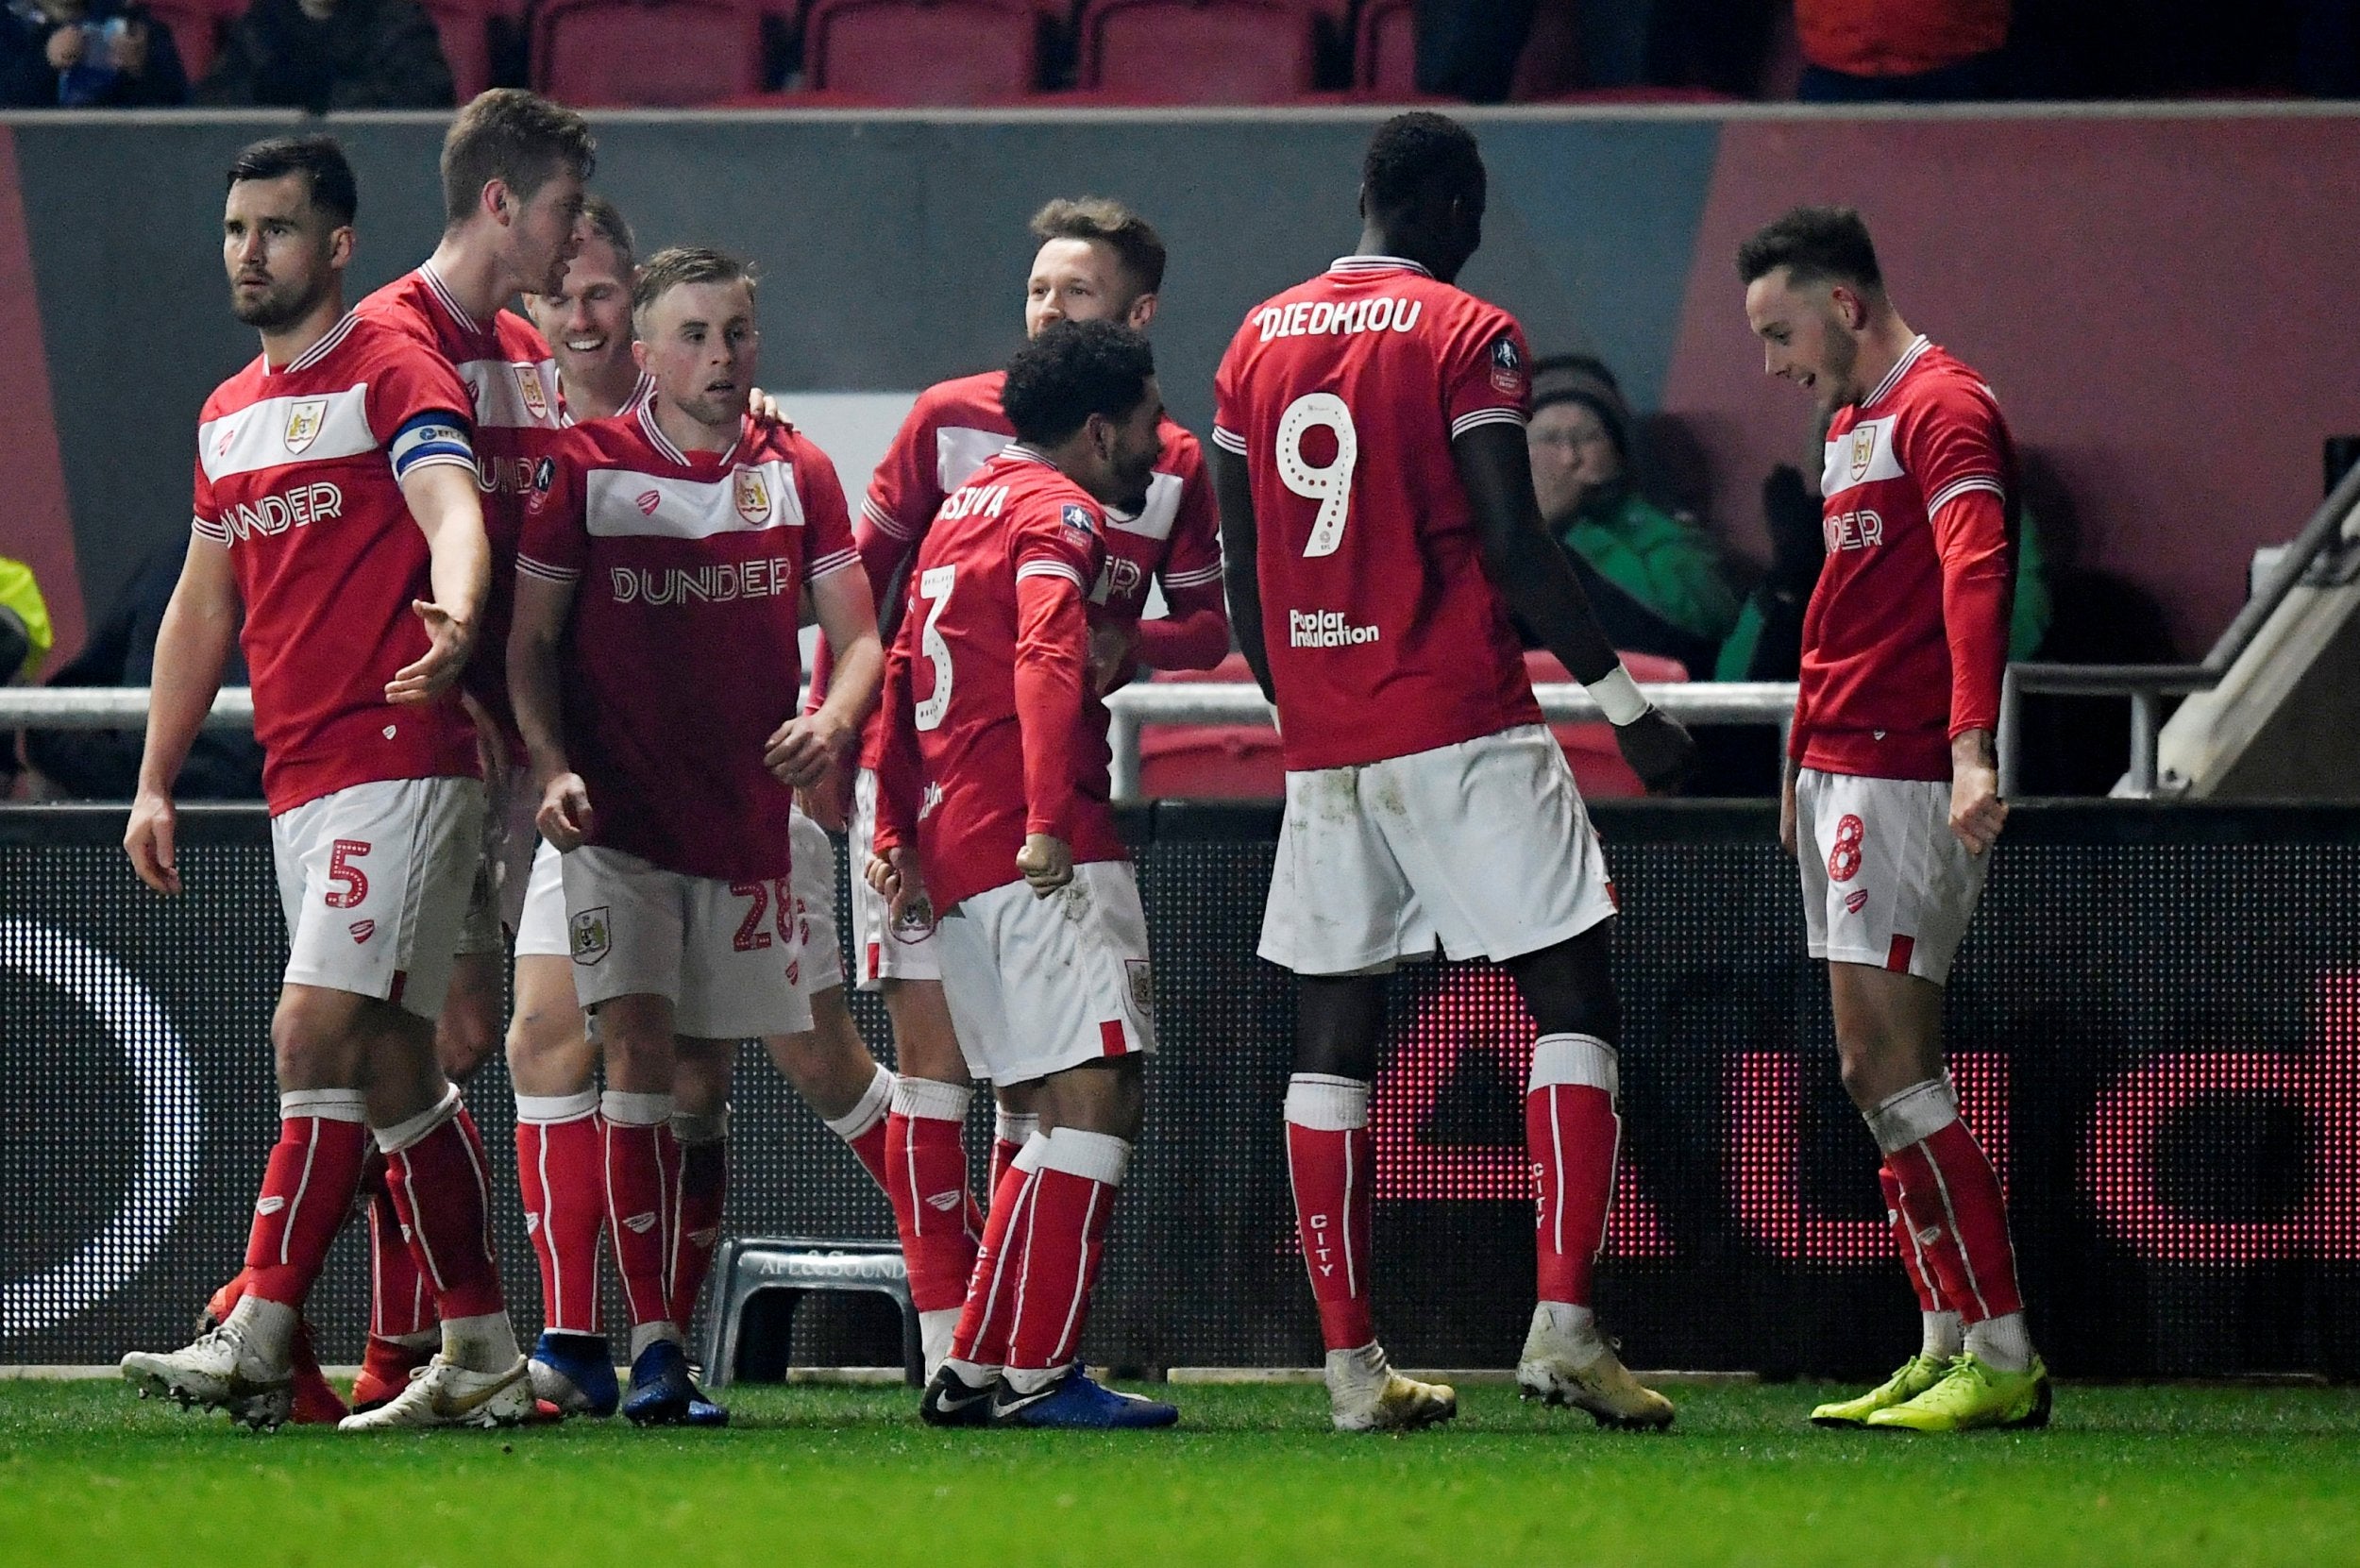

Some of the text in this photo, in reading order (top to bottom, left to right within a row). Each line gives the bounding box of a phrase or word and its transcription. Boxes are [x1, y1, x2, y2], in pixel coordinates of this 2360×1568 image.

[1252, 297, 1423, 343] DIEDHIOU
[1275, 392, 1357, 558] 9
[610, 557, 791, 605] DUNDER
[915, 564, 956, 733] 3
[1290, 625, 1380, 649] Inulation
[325, 838, 372, 909] 5
[1829, 814, 1864, 883] 8
[729, 879, 793, 953] 28
[966, 1246, 988, 1303] CITY
[1310, 1214, 1334, 1277] CITY
